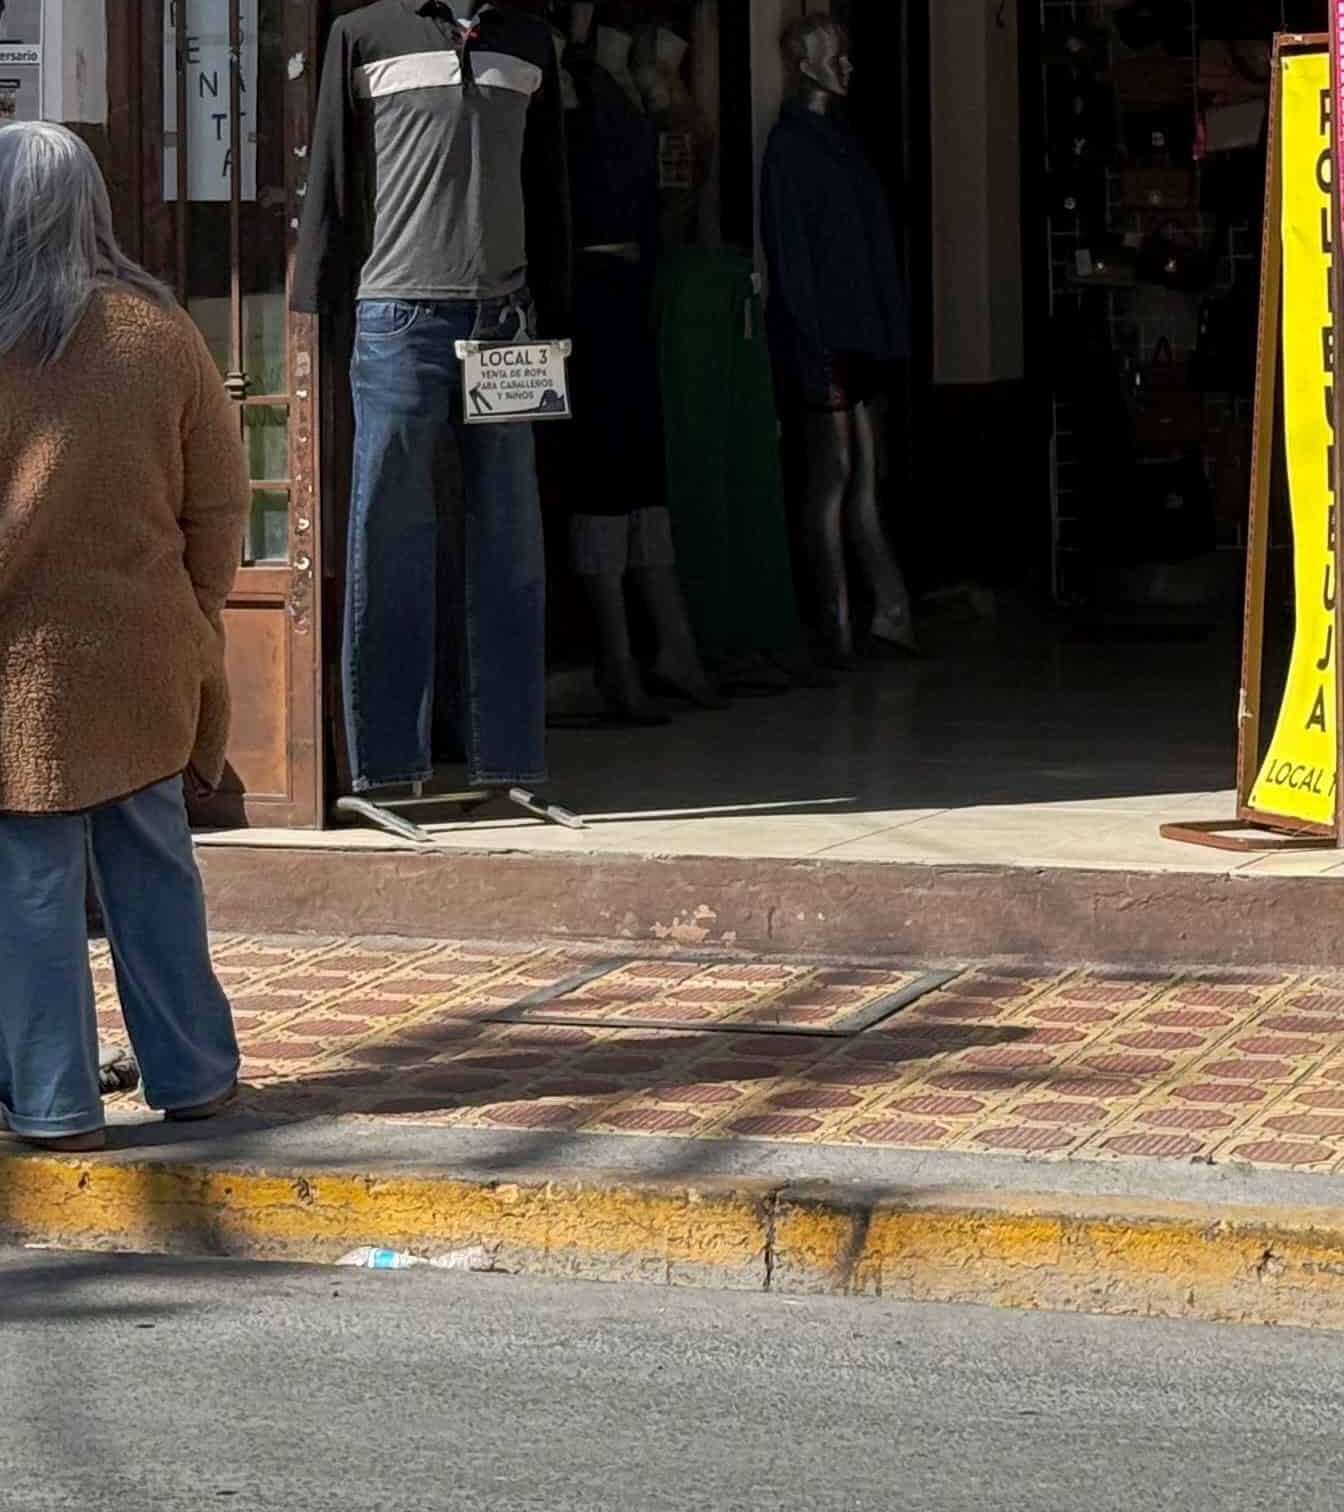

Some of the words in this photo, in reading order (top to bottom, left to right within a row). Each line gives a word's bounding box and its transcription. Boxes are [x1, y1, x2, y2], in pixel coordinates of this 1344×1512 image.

[480, 349, 533, 367] LOCAL
[540, 349, 548, 365] 3
[1265, 759, 1323, 795] LOCAL
